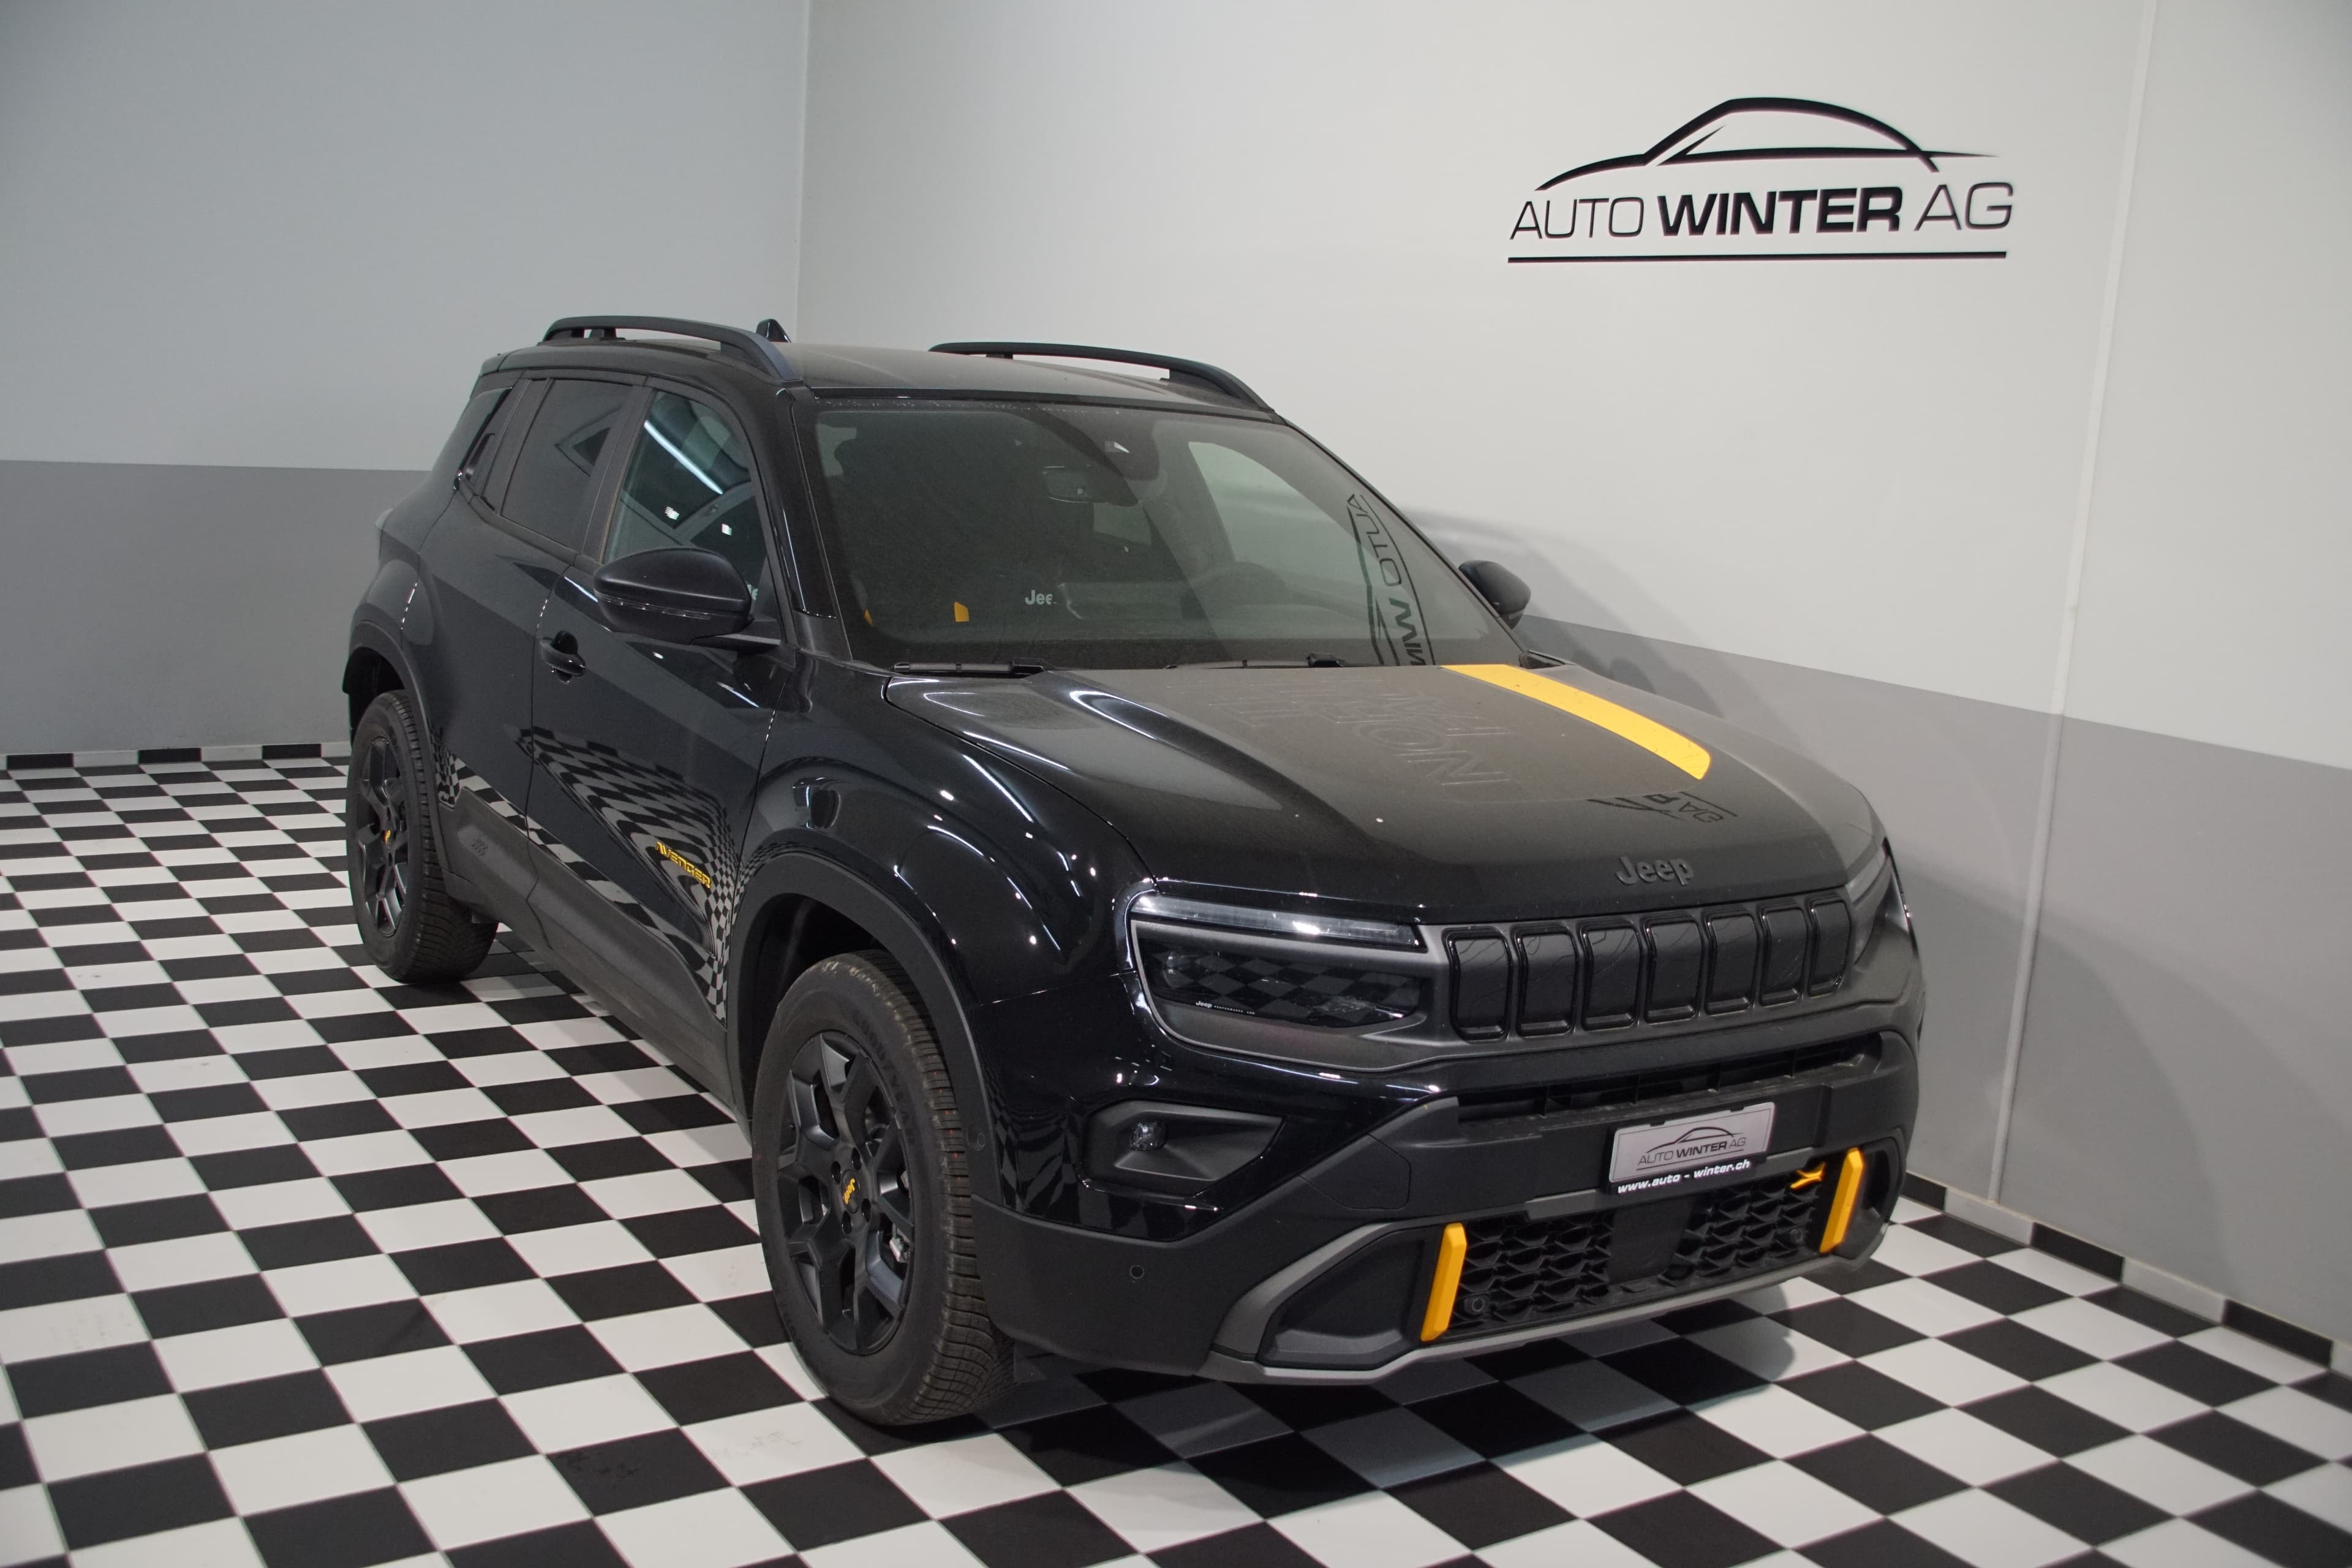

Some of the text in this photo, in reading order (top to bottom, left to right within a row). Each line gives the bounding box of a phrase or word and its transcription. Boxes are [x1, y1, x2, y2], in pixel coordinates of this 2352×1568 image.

[1510, 182, 2015, 240] AUTO WINTER AG
[1025, 589, 1053, 605] Jee
[654, 842, 712, 889] AVENGER
[1615, 856, 1694, 886] Jeep
[1637, 1137, 1746, 1165] AUTO WINTER AG
[1618, 1173, 1680, 1193] www.auto
[1694, 1159, 1750, 1178] winter.ch
